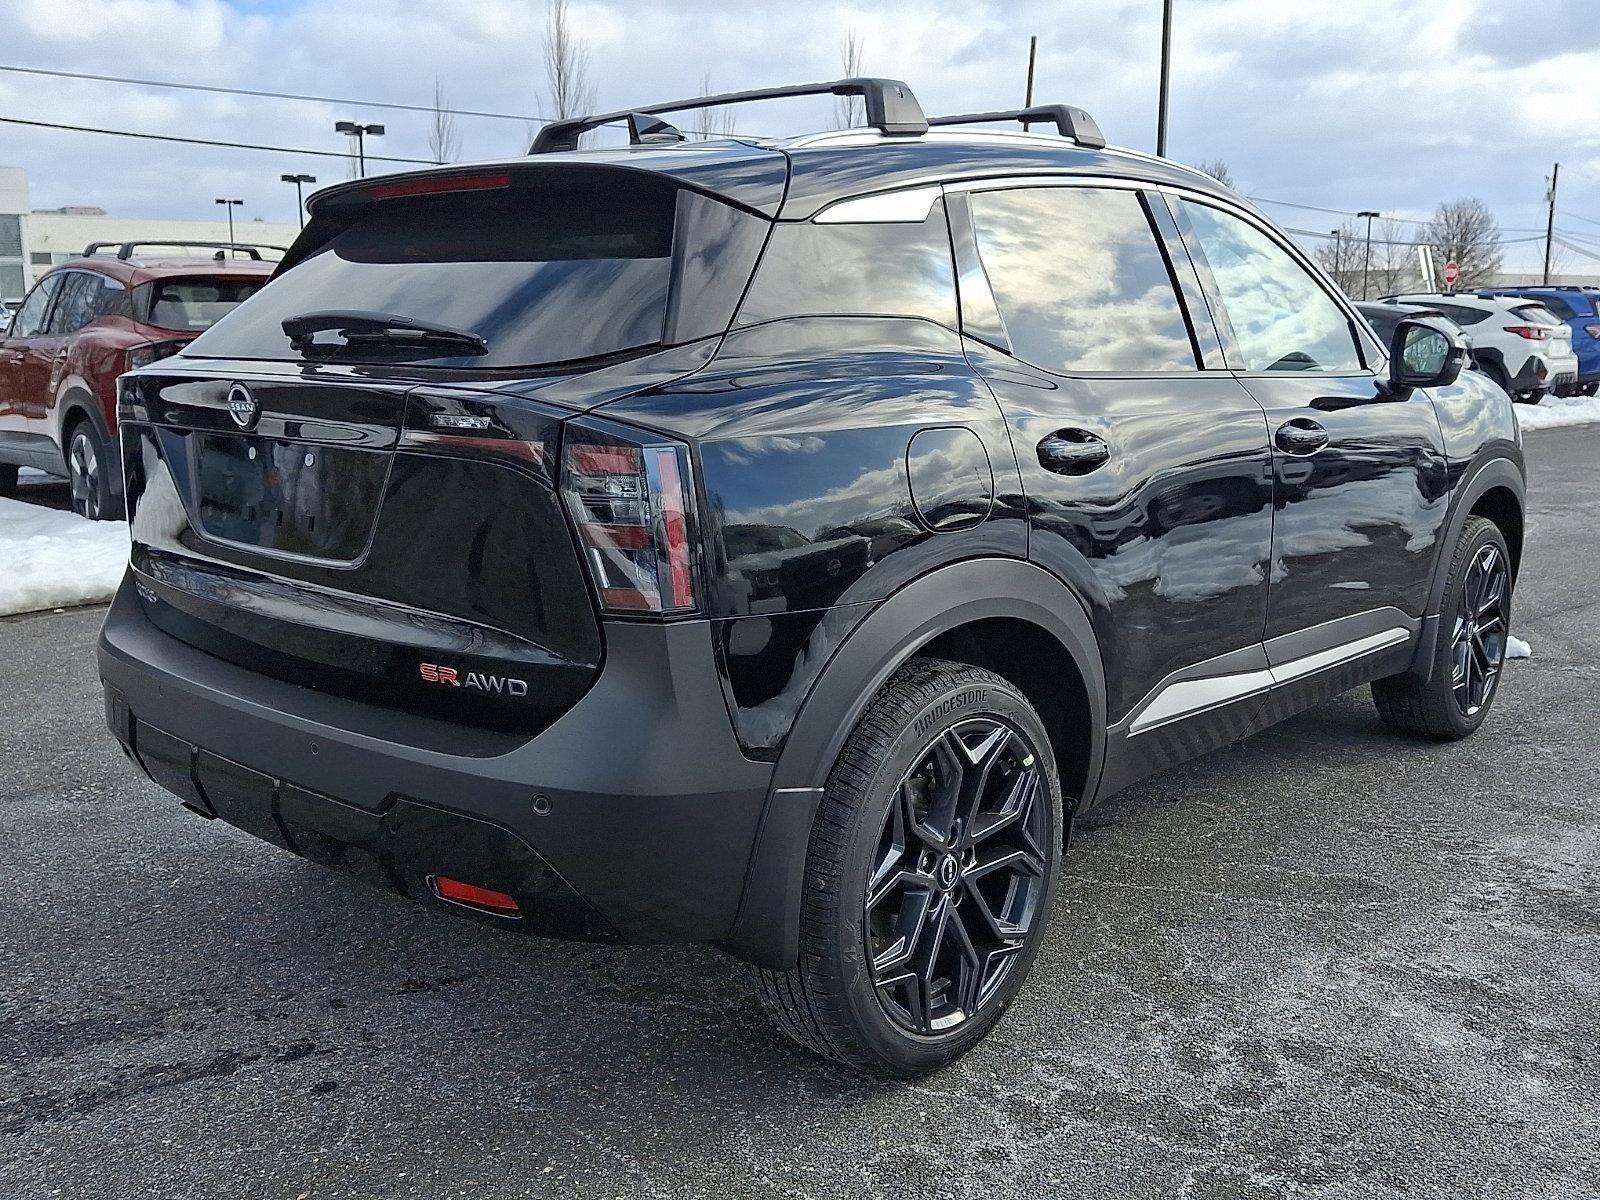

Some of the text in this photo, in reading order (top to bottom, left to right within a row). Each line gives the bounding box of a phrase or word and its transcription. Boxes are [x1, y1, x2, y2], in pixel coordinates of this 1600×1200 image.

[419, 662, 528, 697] SR AWD
[913, 689, 988, 738] BRIDGESTONE
